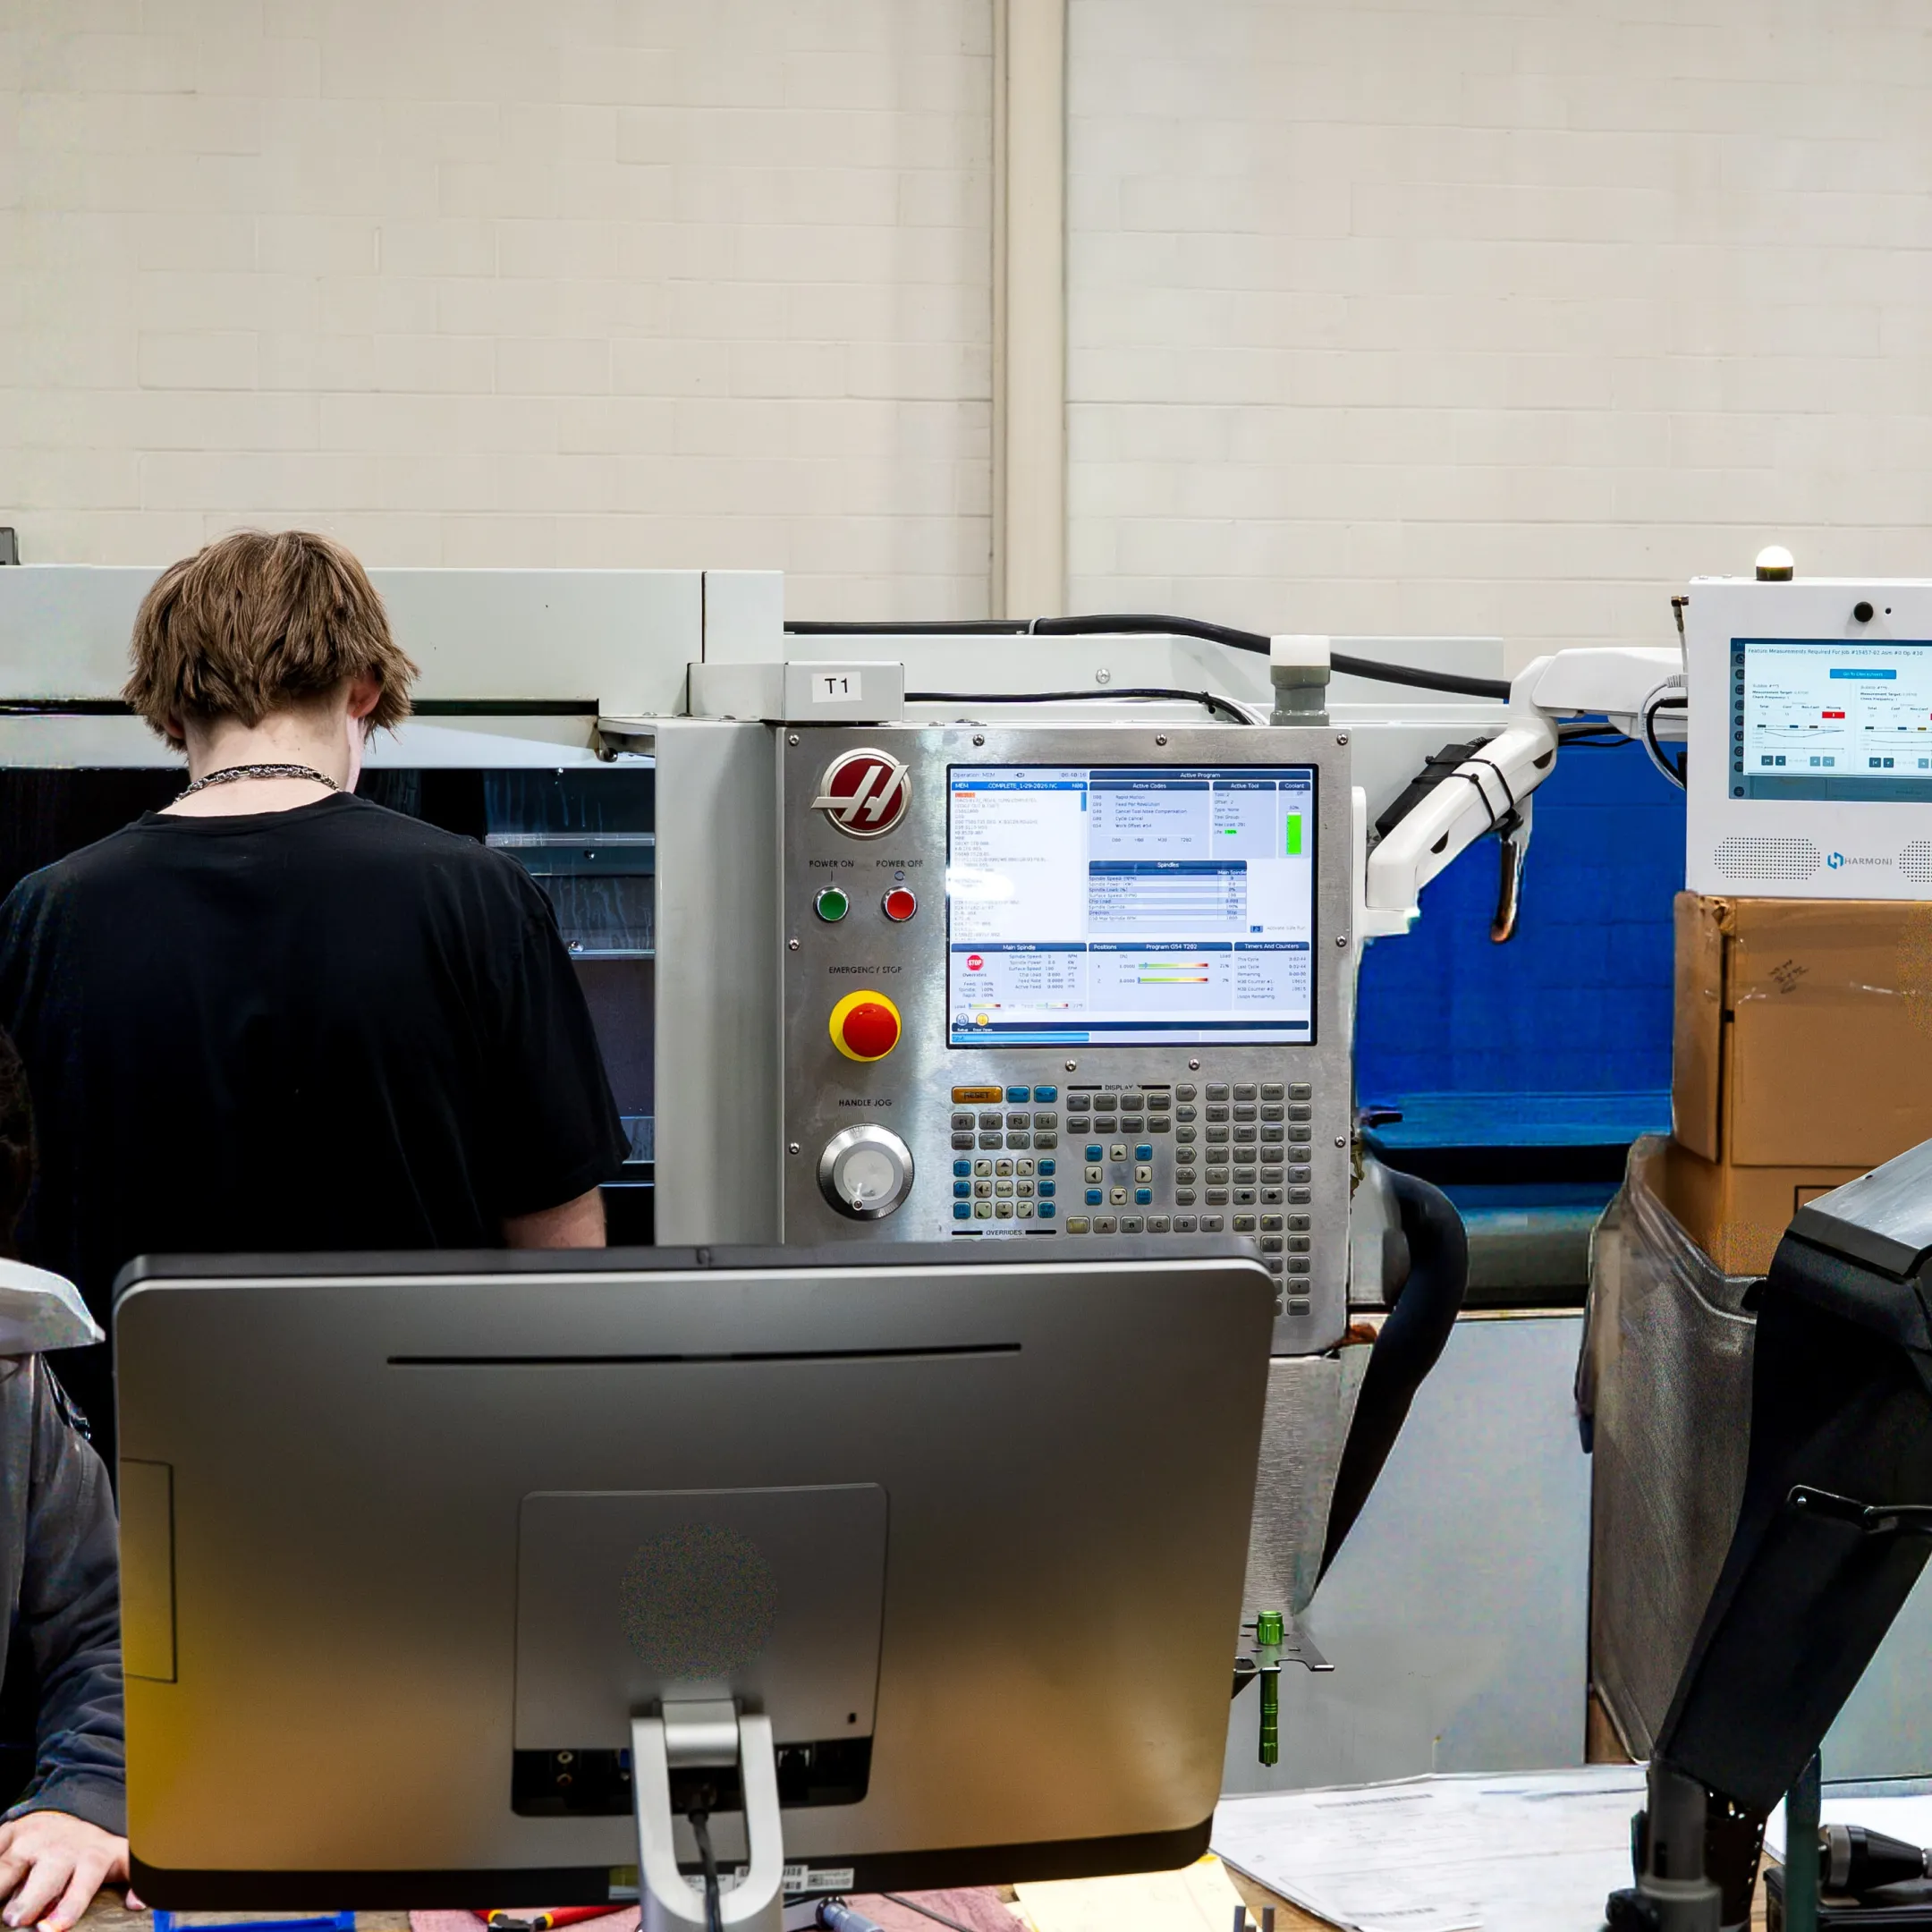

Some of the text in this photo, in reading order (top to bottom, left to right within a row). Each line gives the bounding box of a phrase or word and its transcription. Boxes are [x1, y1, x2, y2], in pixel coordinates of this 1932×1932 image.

[1808, 648, 1831, 657] Required
[824, 677, 848, 694] T1
[809, 860, 854, 868] POWER ON
[876, 860, 924, 868] POWER OFF
[963, 1091, 991, 1099] RESET
[838, 1098, 893, 1107] HANDLE JOG
[1013, 1117, 1023, 1125] F3
[1101, 1221, 1108, 1229] A
[1129, 1221, 1135, 1229] B
[1182, 1220, 1189, 1228] D
[1209, 1220, 1216, 1228] E
